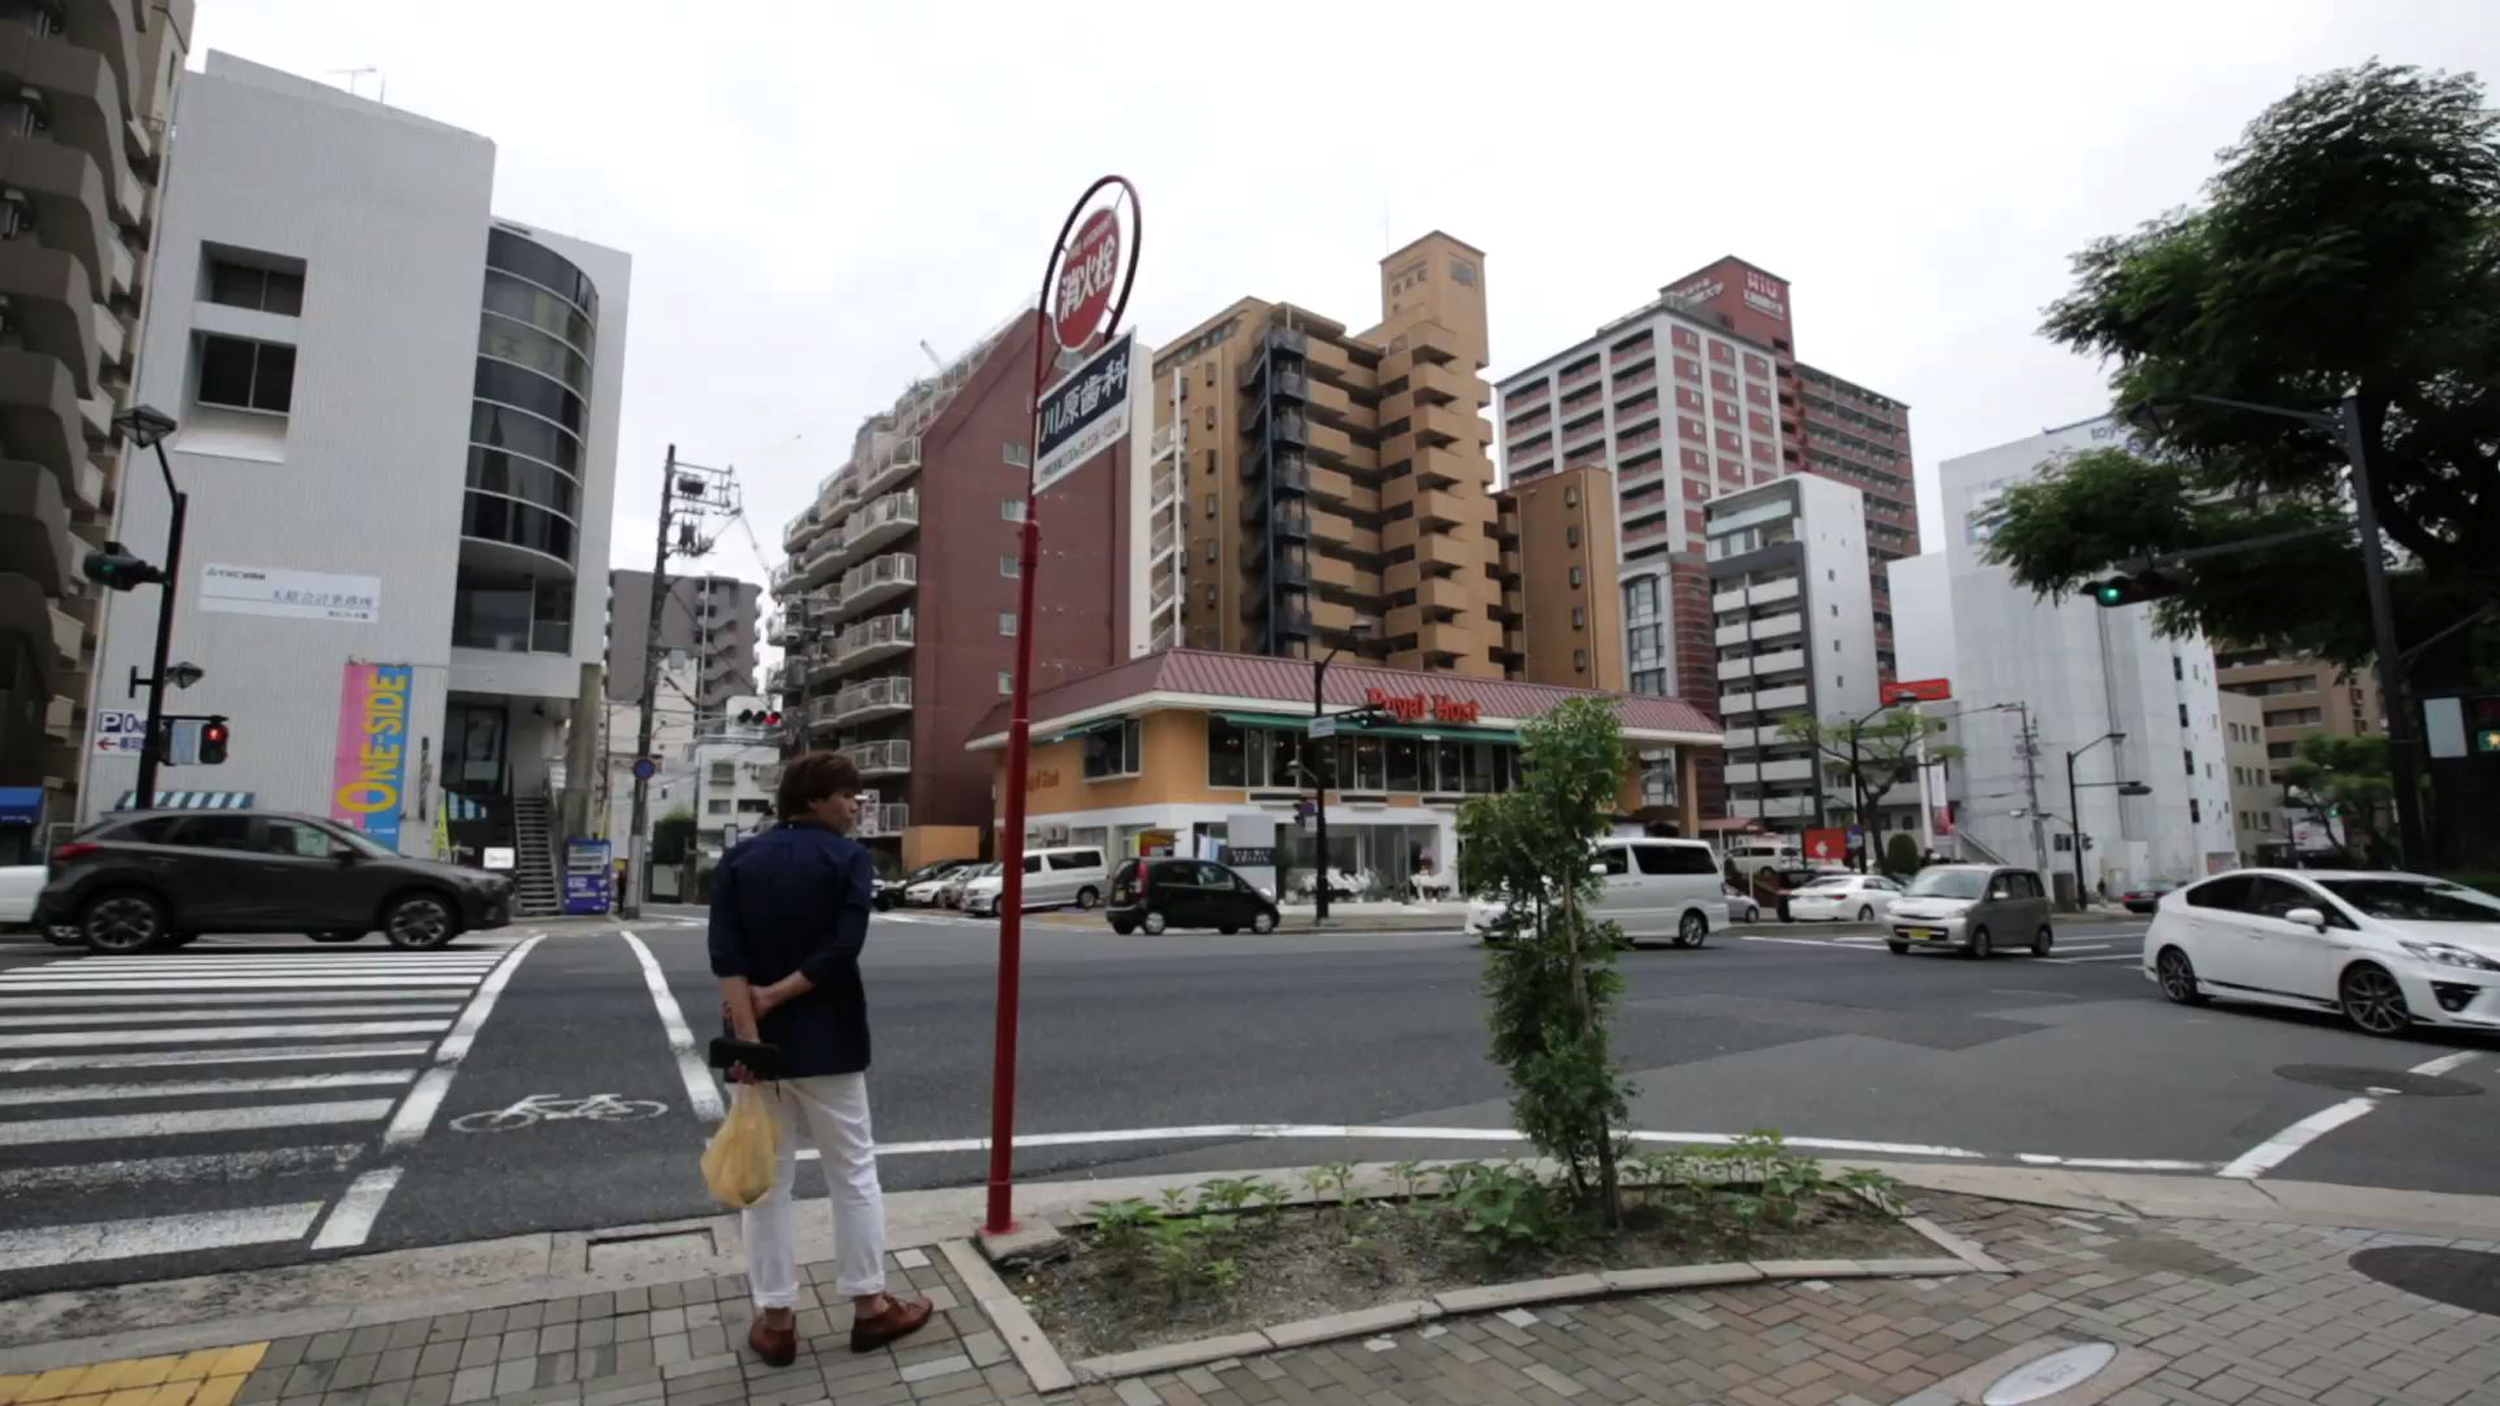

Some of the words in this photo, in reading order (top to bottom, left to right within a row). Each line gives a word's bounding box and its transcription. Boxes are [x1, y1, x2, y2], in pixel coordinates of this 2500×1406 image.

[1060, 234, 1115, 323] 消火栓
[1041, 352, 1127, 442] 川原歯科
